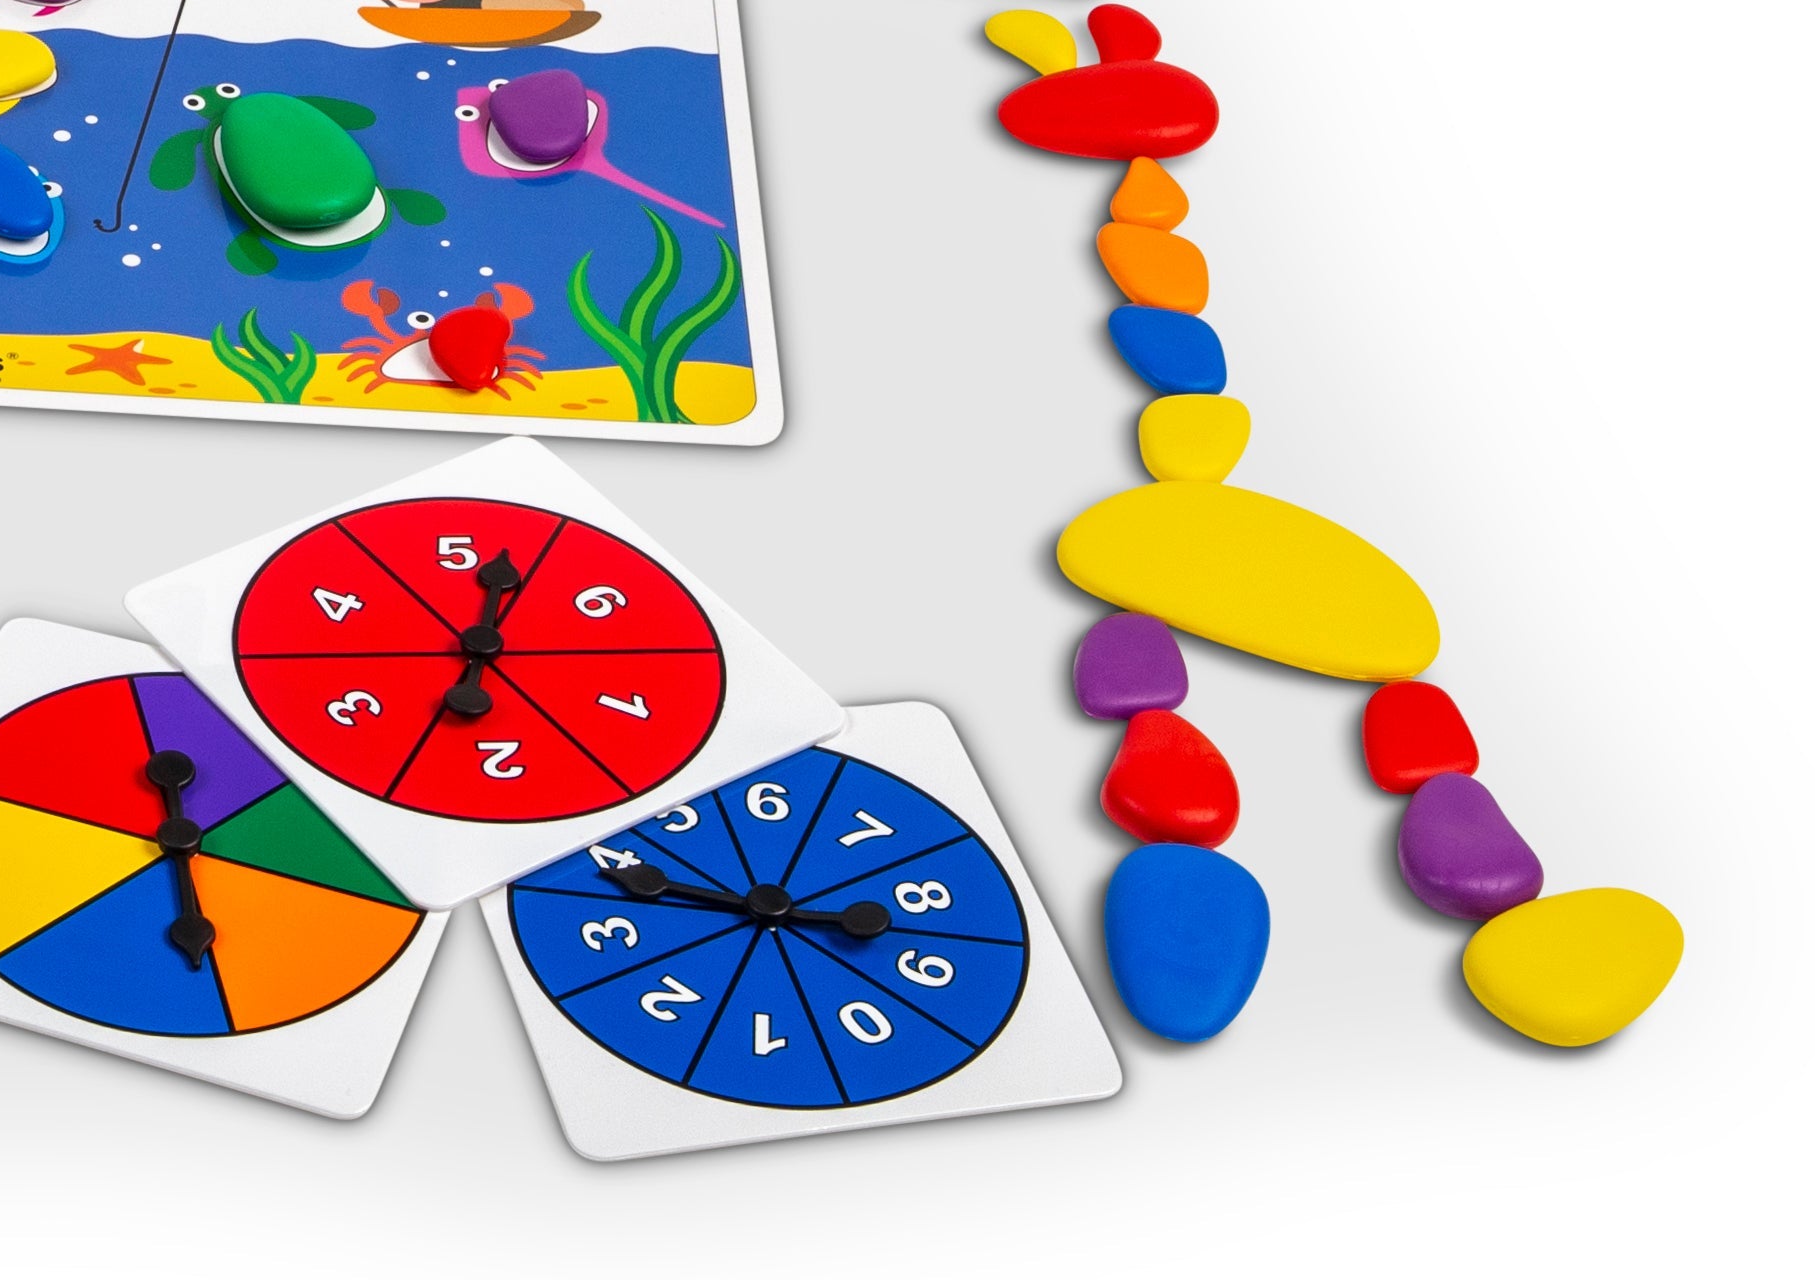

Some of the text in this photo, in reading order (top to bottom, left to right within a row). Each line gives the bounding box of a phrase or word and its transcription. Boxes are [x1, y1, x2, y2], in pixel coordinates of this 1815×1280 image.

[436, 535, 479, 571] 5
[310, 586, 364, 623] 4
[574, 585, 627, 619] 6
[325, 689, 382, 727] 3
[596, 692, 652, 720] 1
[476, 740, 526, 779] 2
[745, 782, 790, 821] 6
[838, 810, 896, 849] 7
[893, 880, 953, 914] 8
[581, 915, 640, 951] 3
[638, 974, 704, 1023] 2
[752, 1012, 789, 1057] 1
[838, 1000, 893, 1045] 0
